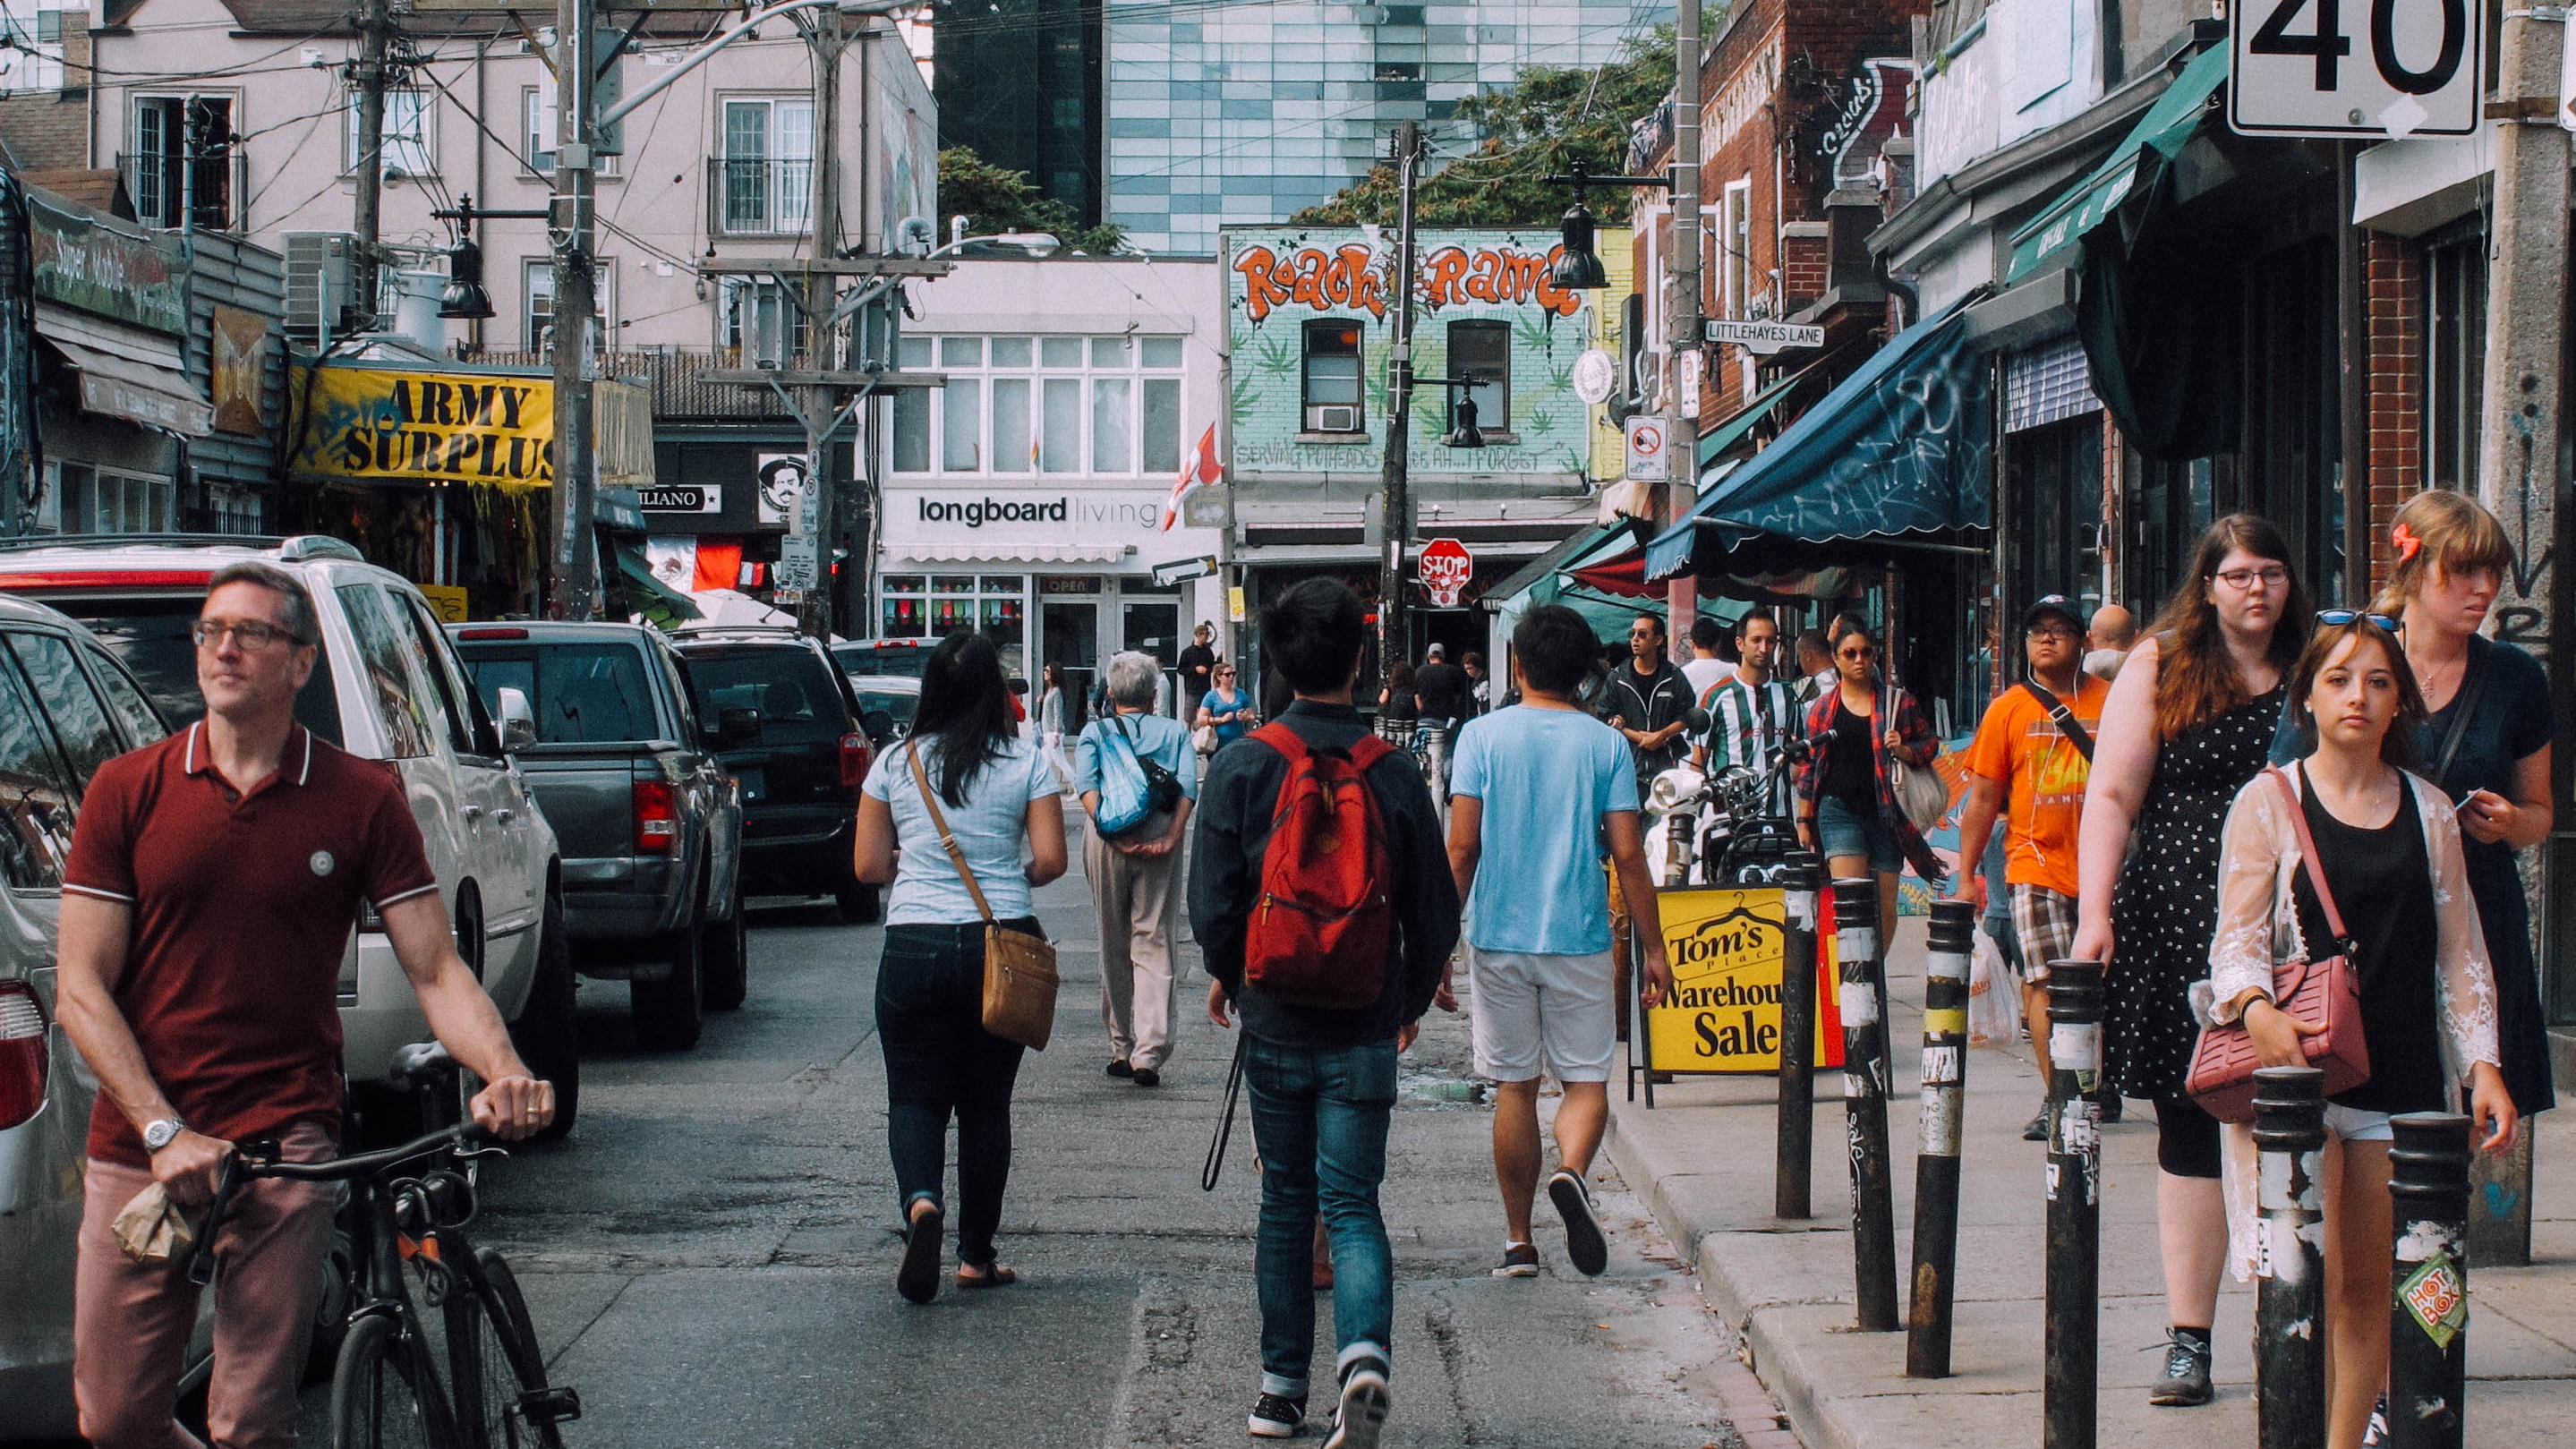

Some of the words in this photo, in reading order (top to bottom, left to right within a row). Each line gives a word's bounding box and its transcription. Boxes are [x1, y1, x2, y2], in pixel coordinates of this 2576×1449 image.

[2249, 0, 2466, 95] 40
[56, 228, 87, 289] Super
[1427, 243, 1581, 317] Rama
[1710, 323, 1787, 341] LITTLEHAYES
[1789, 328, 1821, 343] LANE
[381, 379, 531, 429] ARMY
[1236, 446, 1302, 469] SERVING
[1304, 445, 1379, 469] POTHEADS
[1476, 447, 1542, 473] FORGET
[919, 497, 1068, 527] longboard
[1076, 497, 1158, 528] living
[1422, 555, 1468, 575] STOP
[1669, 922, 1763, 967] Tom's
[1706, 947, 1779, 970] Place
[1693, 1010, 1778, 1058] Sale
[2409, 1270, 2447, 1308] HOT
[2420, 1286, 2461, 1325] BOX
